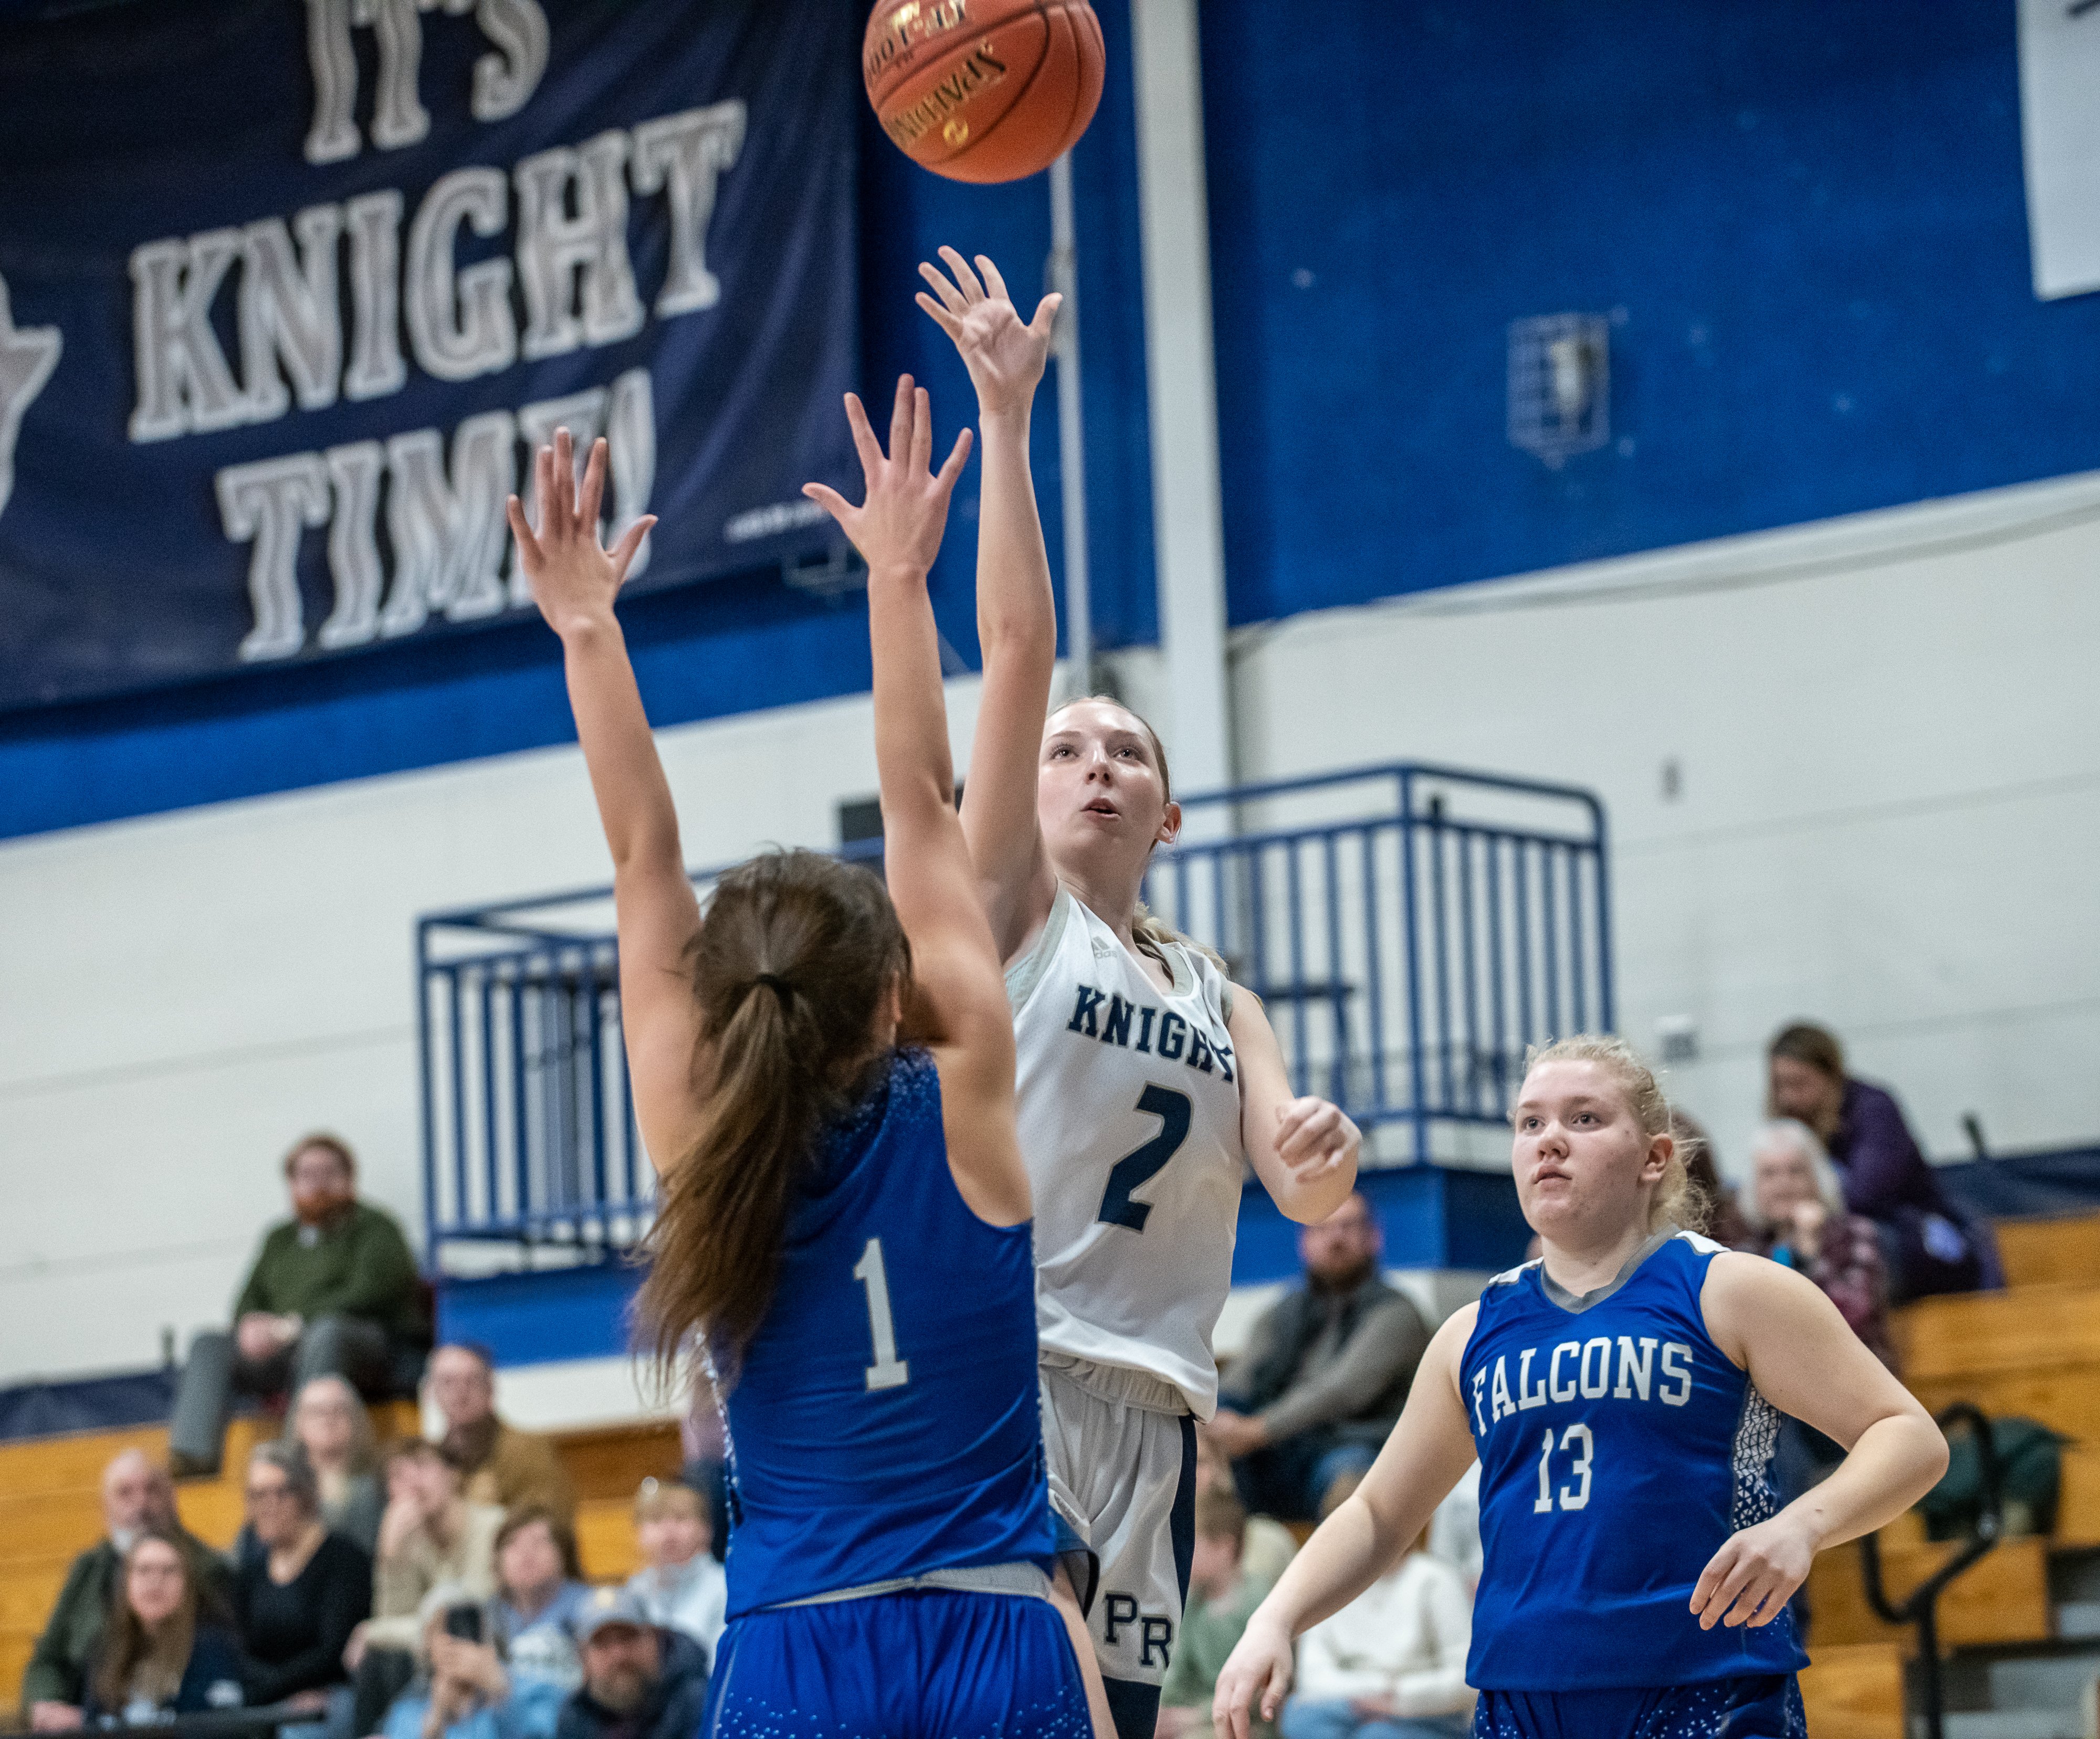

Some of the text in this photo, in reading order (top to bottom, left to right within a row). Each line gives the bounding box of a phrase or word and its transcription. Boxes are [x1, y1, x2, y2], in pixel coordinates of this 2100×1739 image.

[303, 0, 550, 164] ITS
[128, 99, 748, 442] KNIGHT
[1094, 1080, 1195, 1235] 2
[853, 1237, 909, 1393] 1
[1472, 1335, 1694, 1437] FALCONS
[1534, 1423, 1594, 1514] 13
[1104, 1590, 1174, 1673] PR
